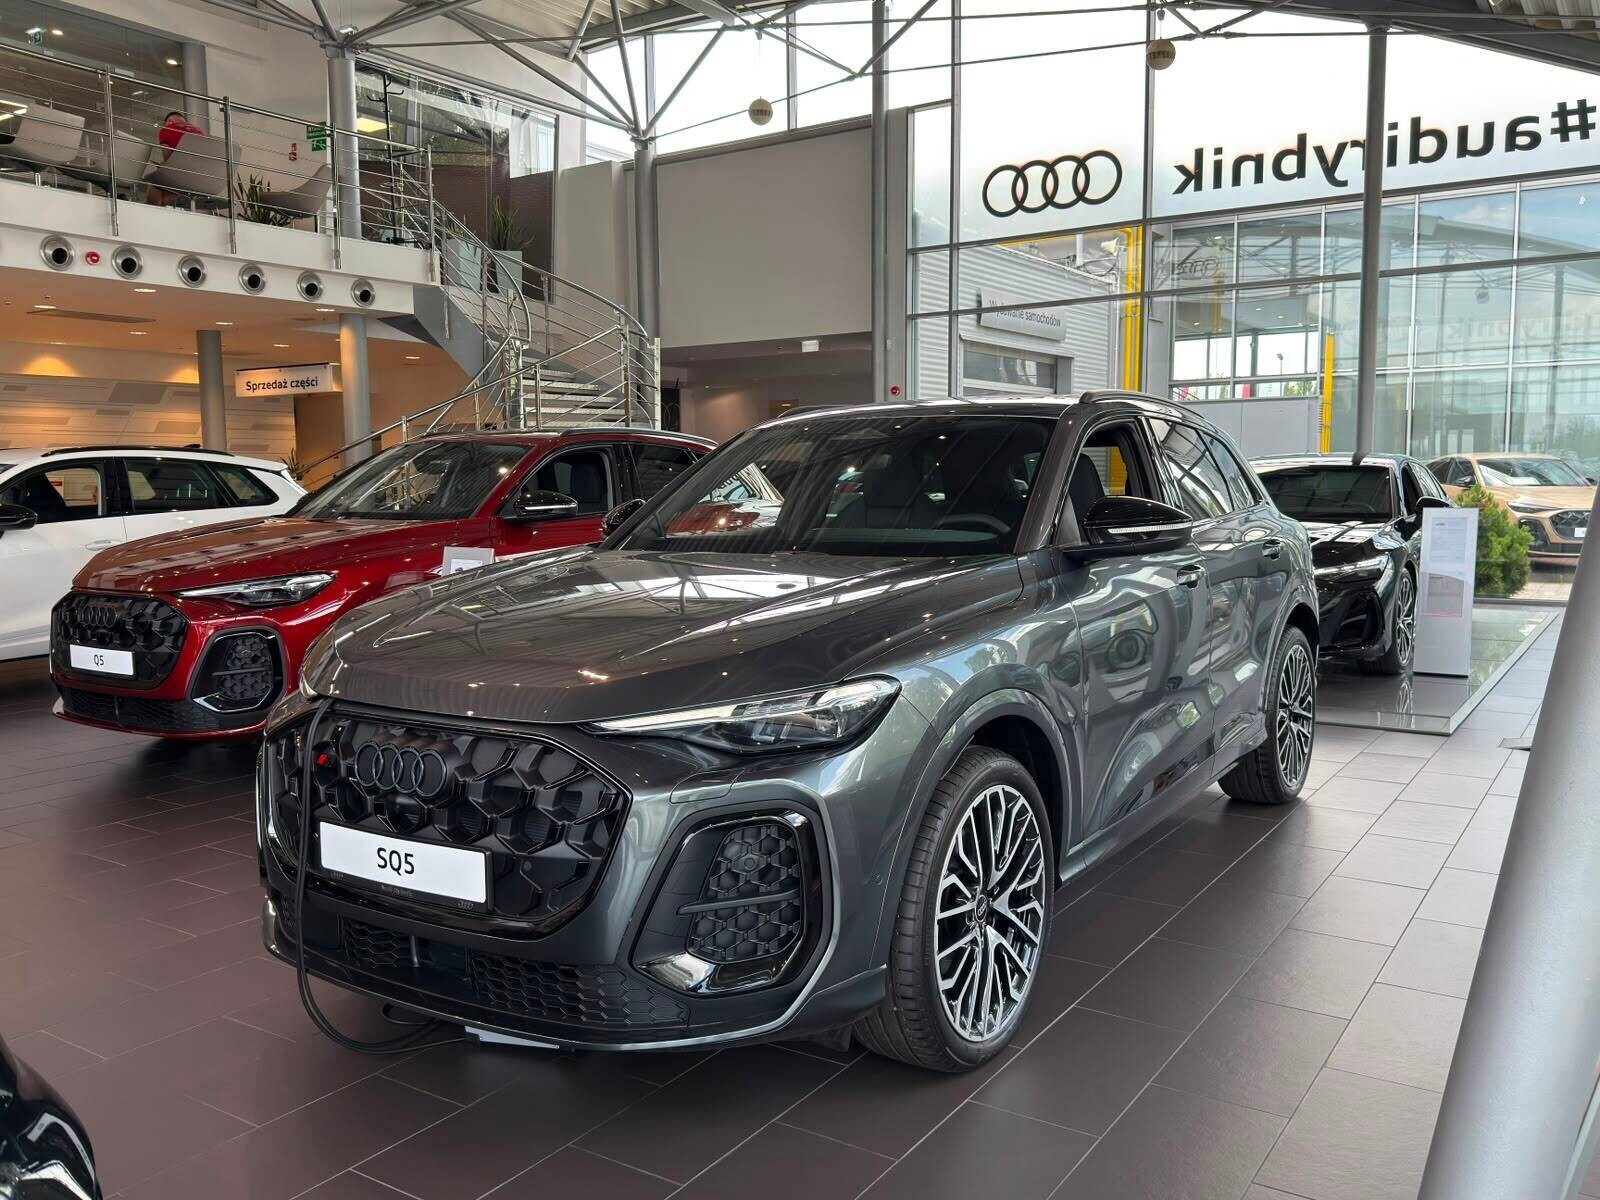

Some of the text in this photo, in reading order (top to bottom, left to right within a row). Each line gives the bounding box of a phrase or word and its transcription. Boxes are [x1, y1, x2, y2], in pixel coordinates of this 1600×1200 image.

[246, 376, 318, 392] Sprzedaż części
[94, 654, 104, 667] Q5
[376, 847, 415, 876] SQ5
